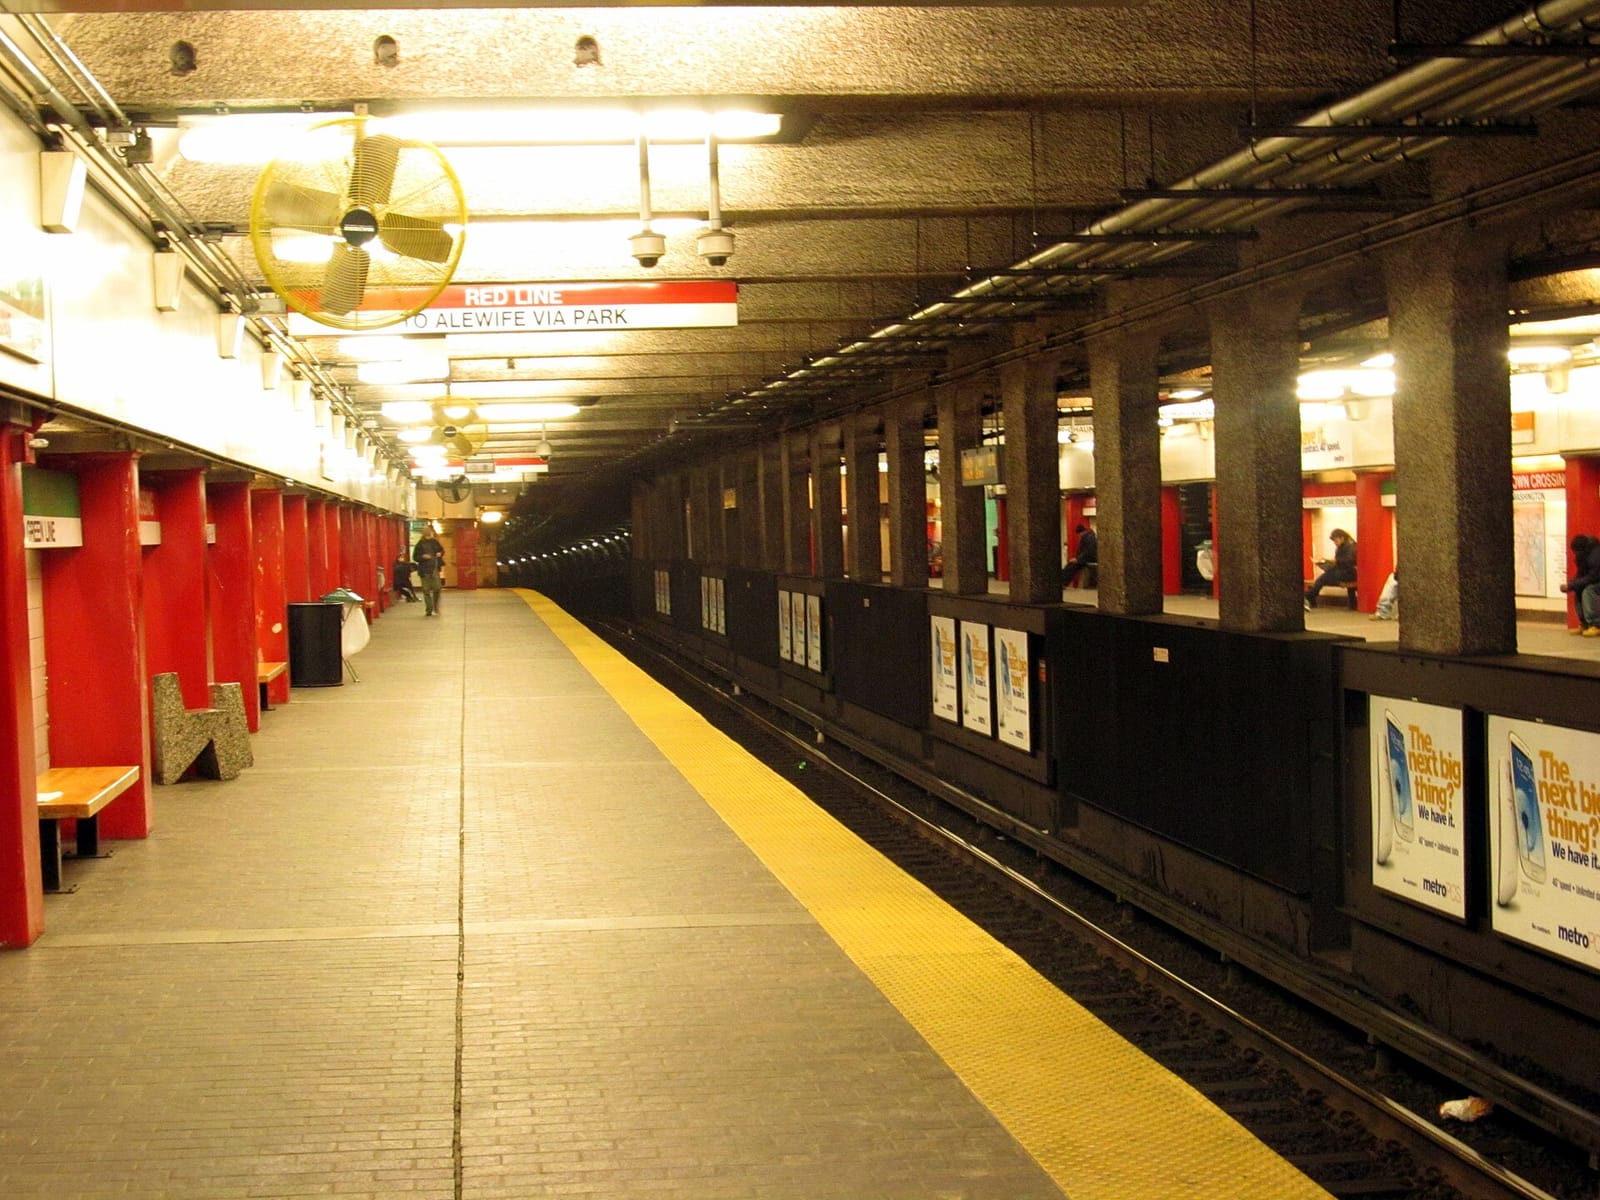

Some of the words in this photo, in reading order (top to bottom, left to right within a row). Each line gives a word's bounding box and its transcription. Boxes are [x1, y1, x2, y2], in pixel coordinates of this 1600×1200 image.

[464, 289, 508, 306] RED
[514, 289, 563, 304] LINE
[435, 311, 526, 328] ALEWIFE
[532, 310, 566, 326] VIA
[574, 308, 628, 325] PARK
[1408, 725, 1432, 753] The
[1408, 750, 1438, 777] next
[1440, 750, 1461, 789] big
[1538, 750, 1570, 783] The
[1415, 775, 1454, 812] thing?
[1537, 779, 1578, 812] next
[1418, 804, 1429, 820] We
[1431, 807, 1447, 826] have
[1546, 807, 1599, 854] thing?
[1552, 841, 1566, 860] We
[1567, 845, 1589, 867] have
